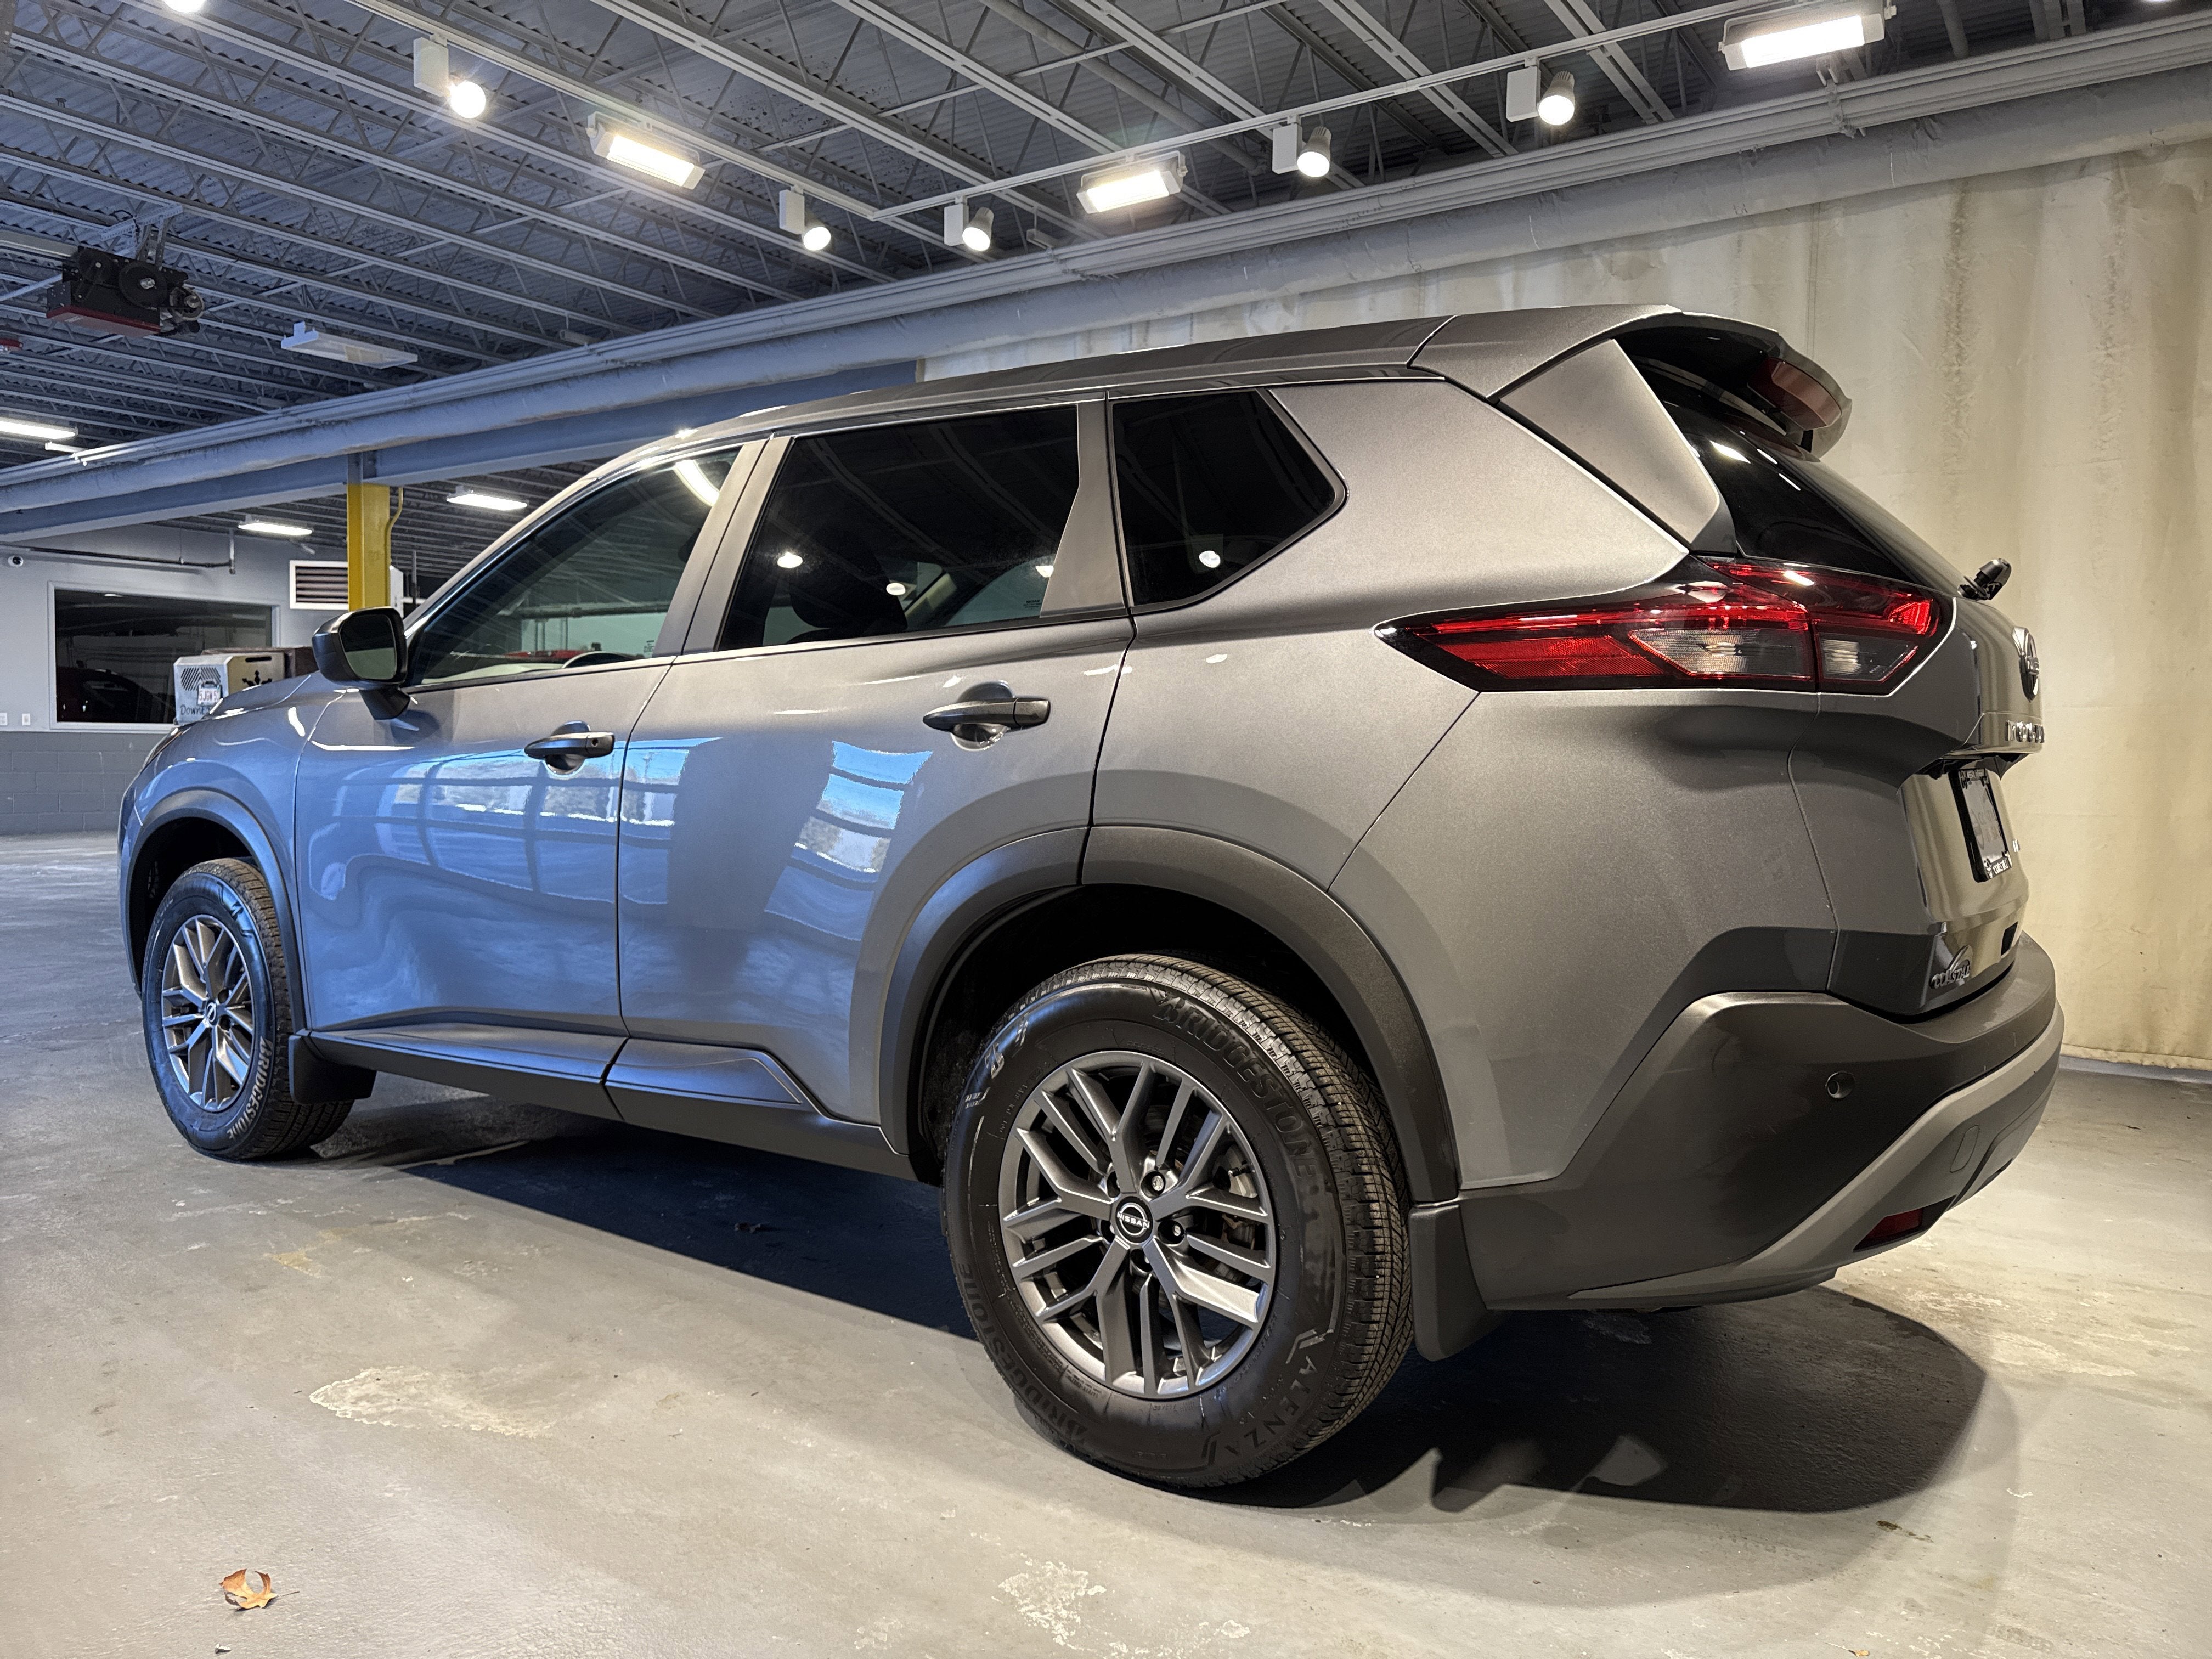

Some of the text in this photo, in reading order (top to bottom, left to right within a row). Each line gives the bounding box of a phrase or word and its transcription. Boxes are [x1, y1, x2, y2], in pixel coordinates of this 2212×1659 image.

[1929, 965, 1970, 989] COASTAL
[226, 1035, 274, 1140] BRIDGESTONE
[1152, 989, 1318, 1179] BRIDGESTONE
[1116, 1211, 1150, 1229] NISSAN
[958, 1263, 1089, 1444] BRIDGESTONE
[1224, 1355, 1317, 1456] ALENZA
